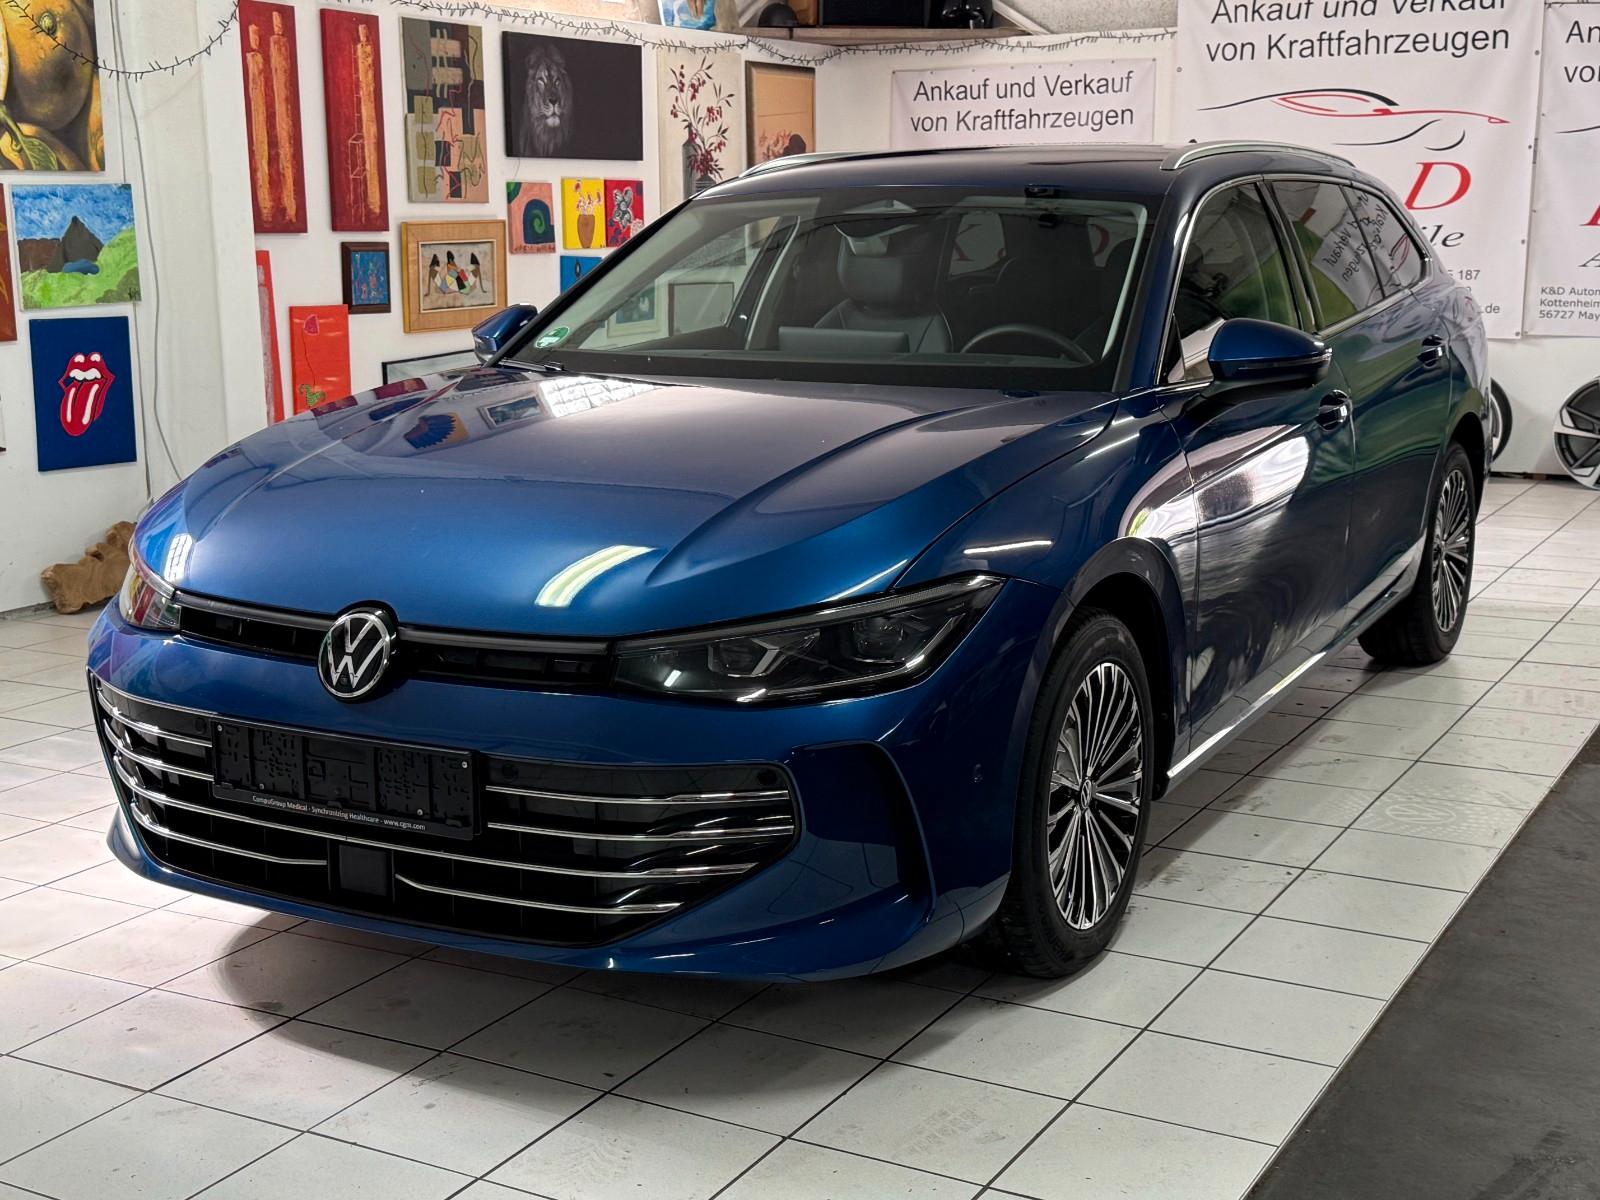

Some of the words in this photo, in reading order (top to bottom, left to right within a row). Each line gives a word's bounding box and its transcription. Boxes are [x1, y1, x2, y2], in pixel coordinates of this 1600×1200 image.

[1324, 0, 1378, 18] und
[1206, 42, 1255, 62] von
[1267, 29, 1509, 59] Kraftfahrzeugen
[1564, 65, 1600, 83] vo
[913, 78, 990, 102] Ankauf
[996, 76, 1036, 98] und
[1043, 70, 1134, 97] Verkauf
[910, 115, 948, 132] von
[956, 108, 1134, 132] Kraftfahrzeugen
[1458, 270, 1480, 280] 187
[1541, 286, 1566, 296] K&D
[1539, 310, 1575, 320] 56727
[287, 801, 308, 811] Medical
[349, 812, 380, 823] Healthcare
